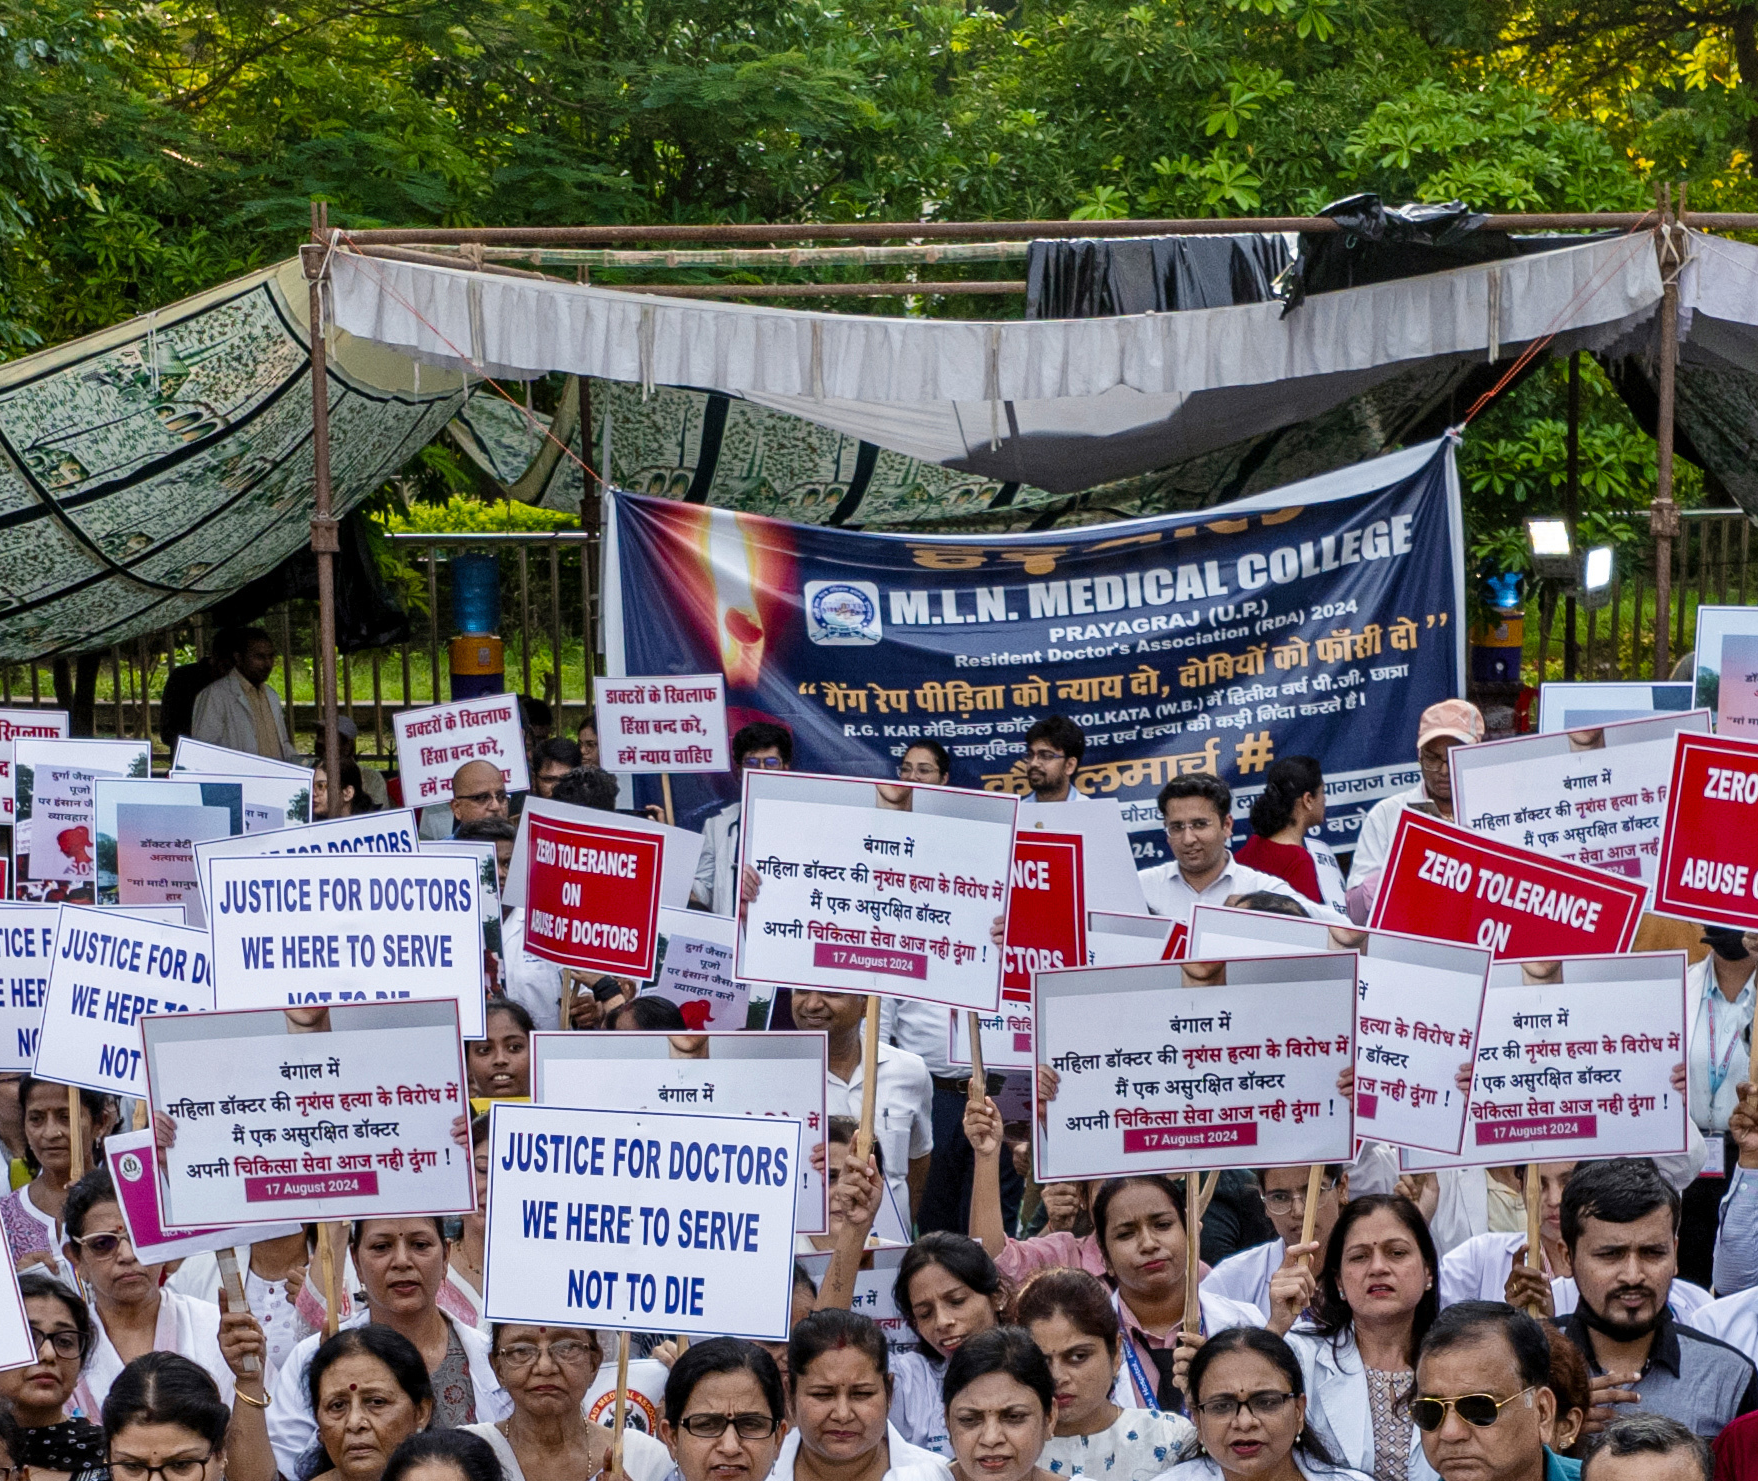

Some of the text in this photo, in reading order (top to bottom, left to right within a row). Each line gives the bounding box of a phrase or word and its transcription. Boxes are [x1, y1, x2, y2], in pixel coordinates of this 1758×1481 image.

[889, 586, 1019, 625] M.L.N.
[1029, 561, 1228, 619] MEDICAL
[1238, 513, 1413, 591] COLLEGE
[955, 599, 1358, 668] Resident Doctor's Association (RDA) 2024
[1049, 599, 1268, 642] PRAYAGRAJ (U.P.)
[867, 683, 908, 713] रेप
[1011, 675, 1050, 707] को
[1056, 675, 1123, 702] न्याय
[1130, 665, 1171, 698] दो,
[1179, 642, 1265, 688] दोषियों
[1273, 637, 1309, 670] को
[1389, 616, 1418, 650] दो
[279, 1057, 340, 1080] बंगाल में
[167, 1082, 458, 1120] महिला डॉक्टर की नृशंस हत्या के विरोध में
[232, 1119, 399, 1147] मैं एक असुरक्षित डॉक्टर
[187, 1148, 437, 1178] अपनी चिकित्सा सेवा आज नही दूंगा
[502, 1133, 788, 1186] JUSTICE FOR DOCTORS
[266, 1179, 358, 1196] 17 August 2024
[523, 1200, 759, 1252] WE HERE TO SERVE
[568, 1270, 704, 1316] NOT TO DIE
